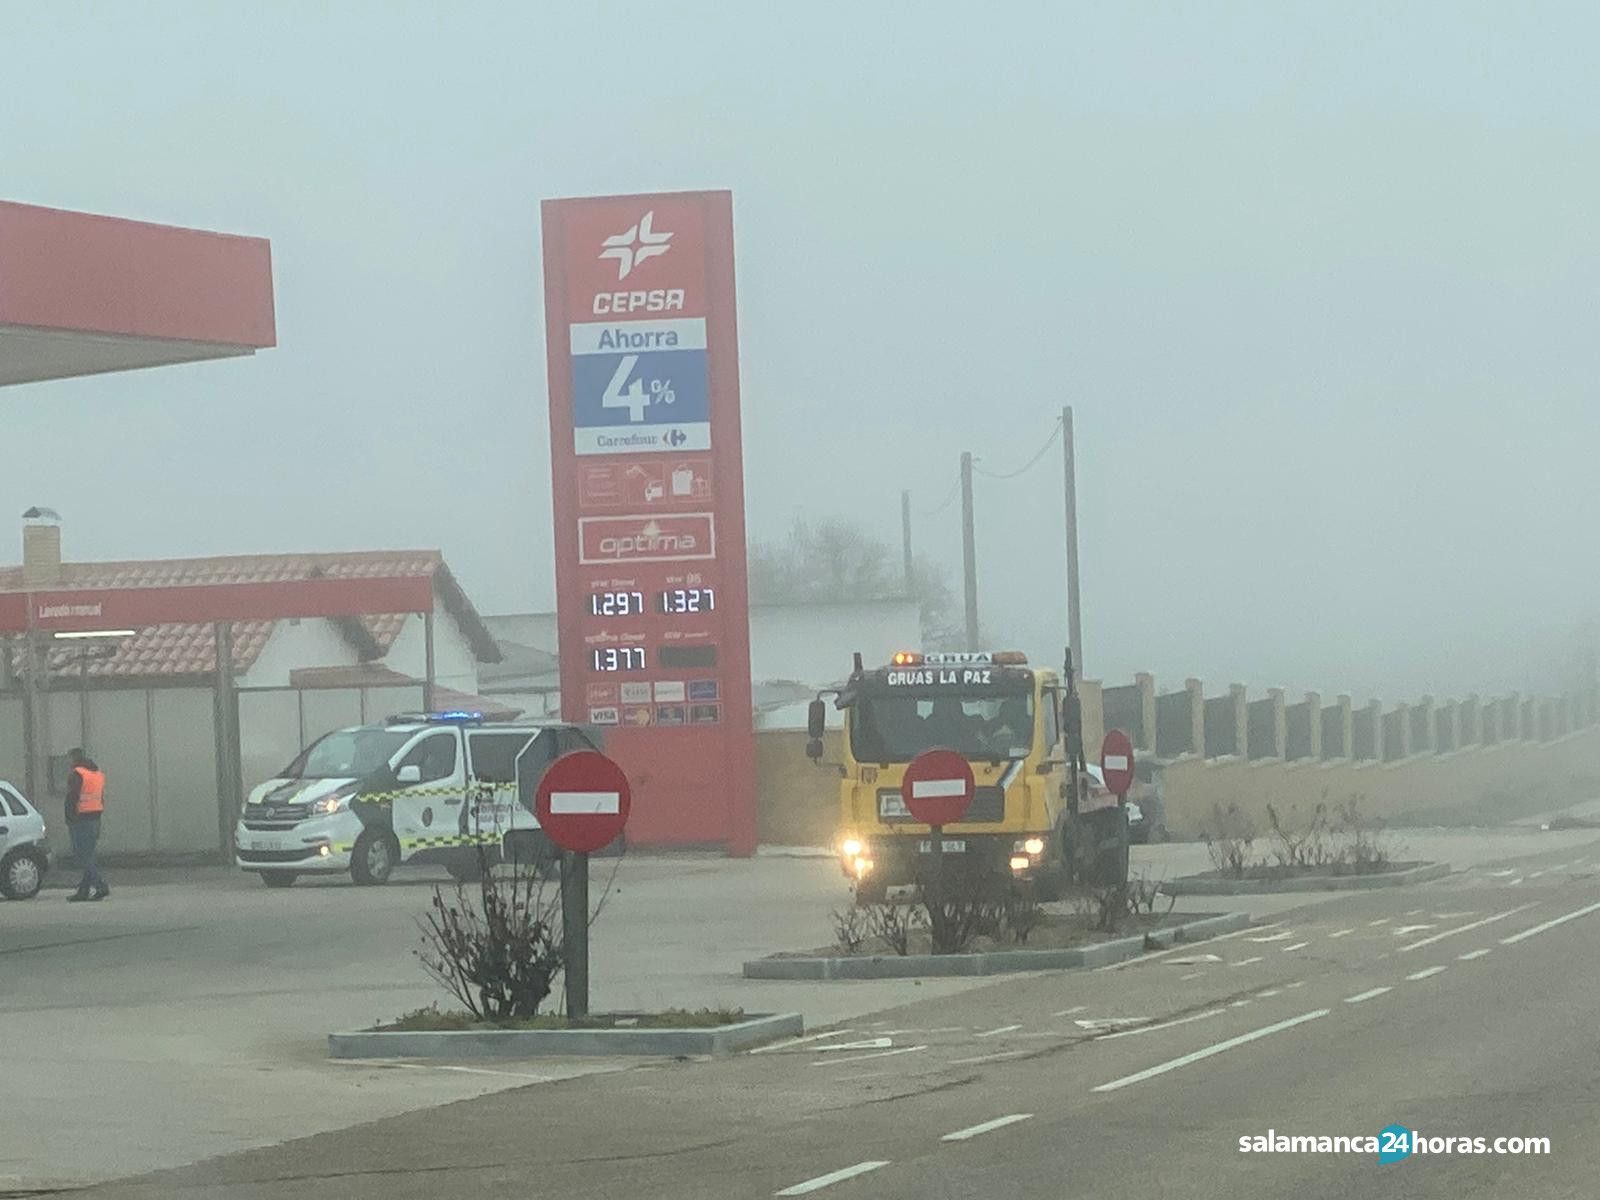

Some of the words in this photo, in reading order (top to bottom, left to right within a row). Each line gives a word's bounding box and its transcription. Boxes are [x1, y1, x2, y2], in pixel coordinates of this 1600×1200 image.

[593, 289, 684, 314] CEPSA
[598, 328, 679, 350] Ahorra
[602, 355, 675, 422] 4%
[597, 433, 658, 448] Carrefour
[599, 531, 697, 558] optima
[592, 591, 644, 616] 1.297
[663, 588, 715, 613] 1.327
[594, 647, 646, 671] 1.377
[926, 654, 990, 664] GRUA
[887, 670, 934, 685] GRUAS
[939, 670, 957, 684] LA
[963, 670, 991, 684] PAZ
[592, 711, 616, 721] VISA
